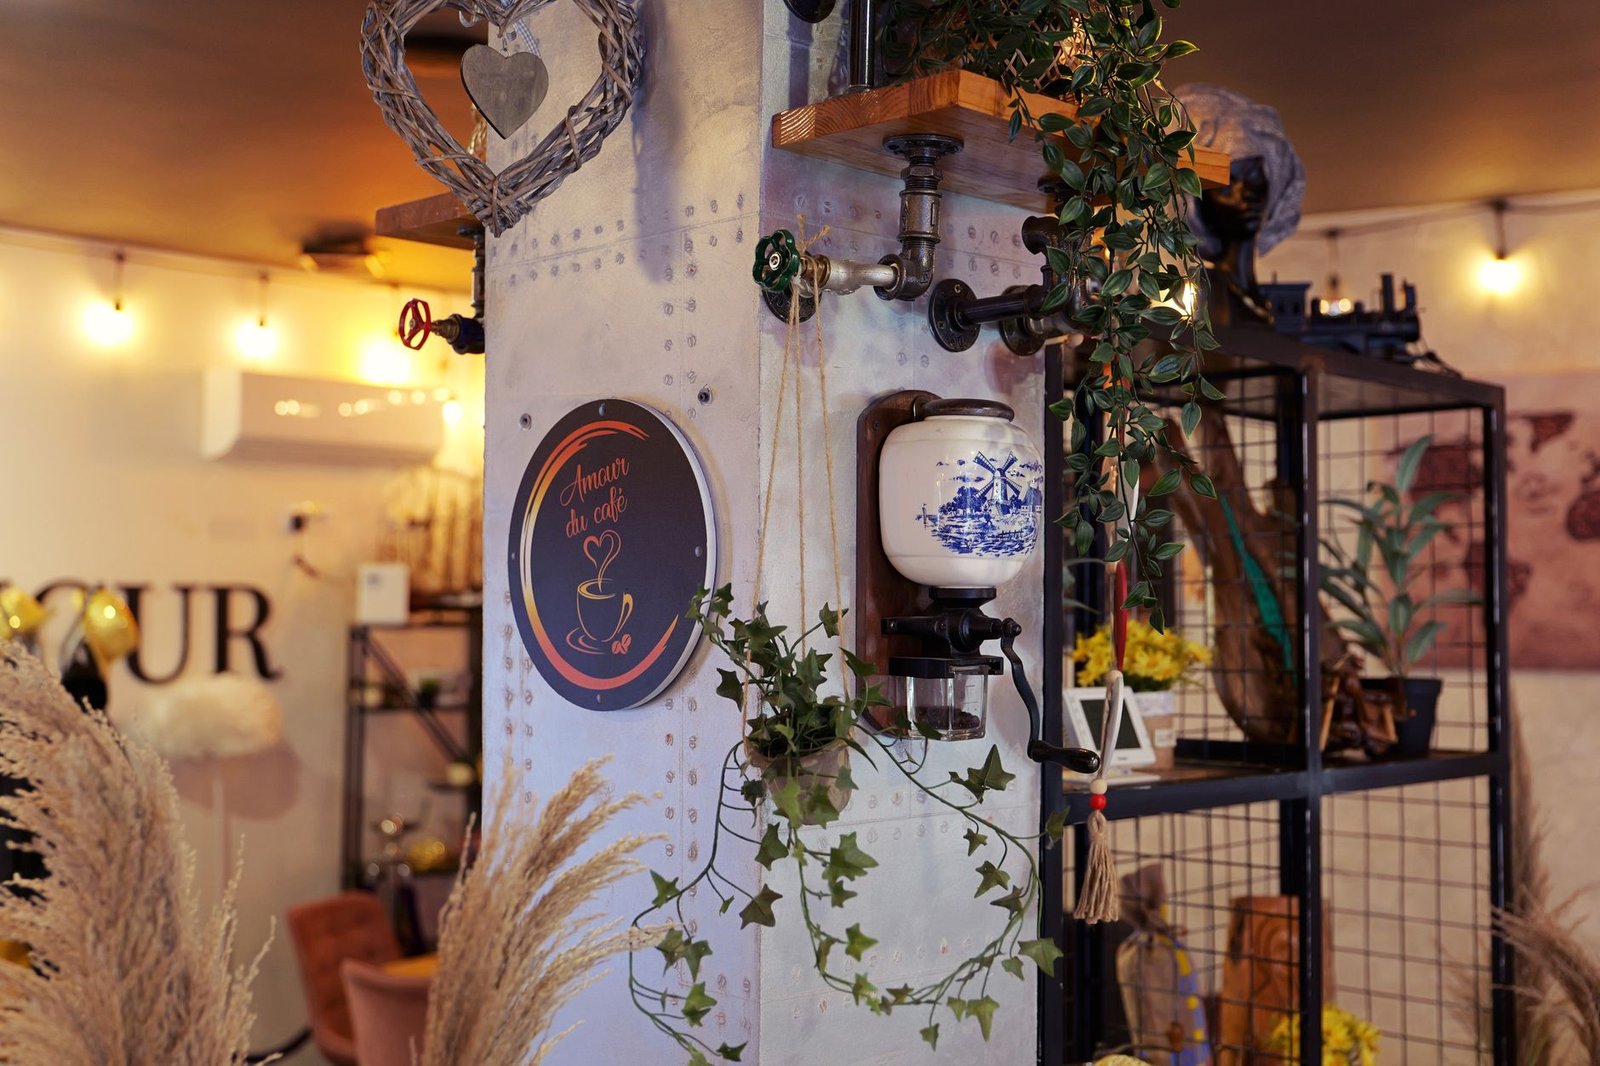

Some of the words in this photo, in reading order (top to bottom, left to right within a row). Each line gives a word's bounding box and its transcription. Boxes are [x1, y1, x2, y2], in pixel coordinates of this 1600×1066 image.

[560, 457, 630, 507] Amour
[565, 509, 589, 538] du
[593, 486, 628, 524] café
